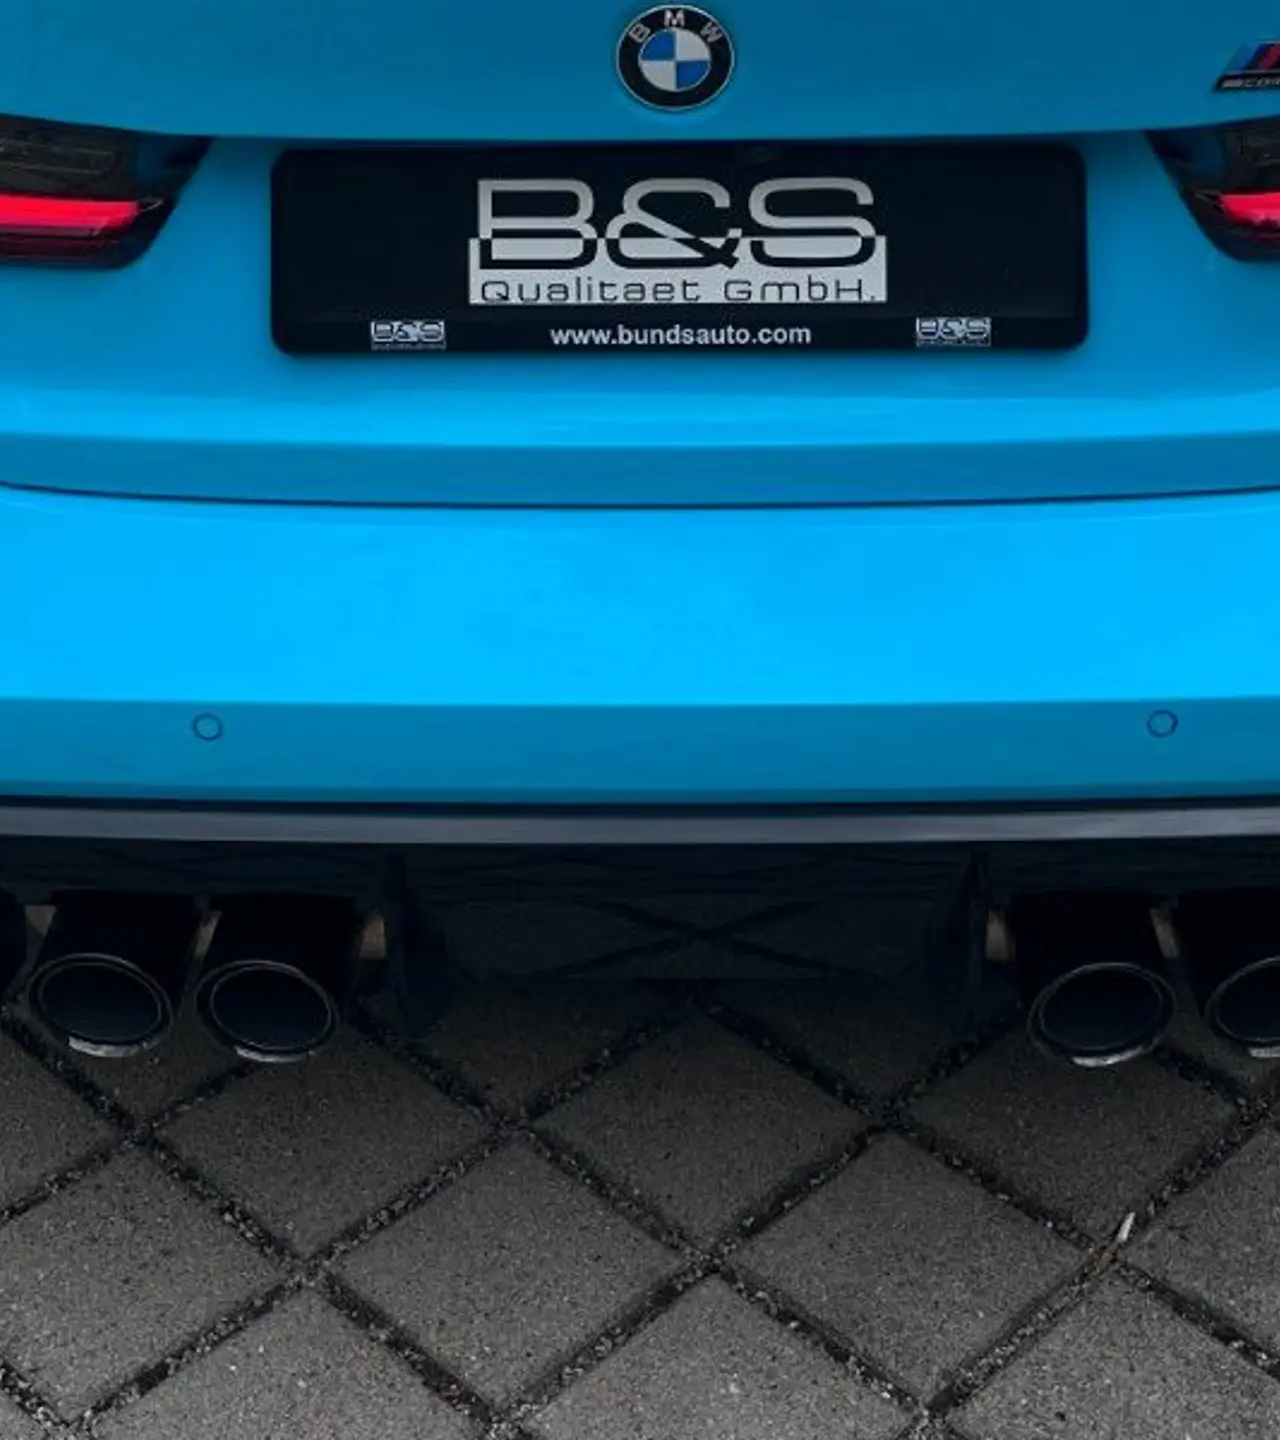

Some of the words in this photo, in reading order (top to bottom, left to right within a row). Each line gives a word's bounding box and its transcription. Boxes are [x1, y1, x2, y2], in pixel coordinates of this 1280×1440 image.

[628, 9, 723, 43] BMW
[477, 177, 877, 270] B&S
[480, 275, 701, 303] Qualitaet
[551, 323, 812, 345] www.bundsauto.com
